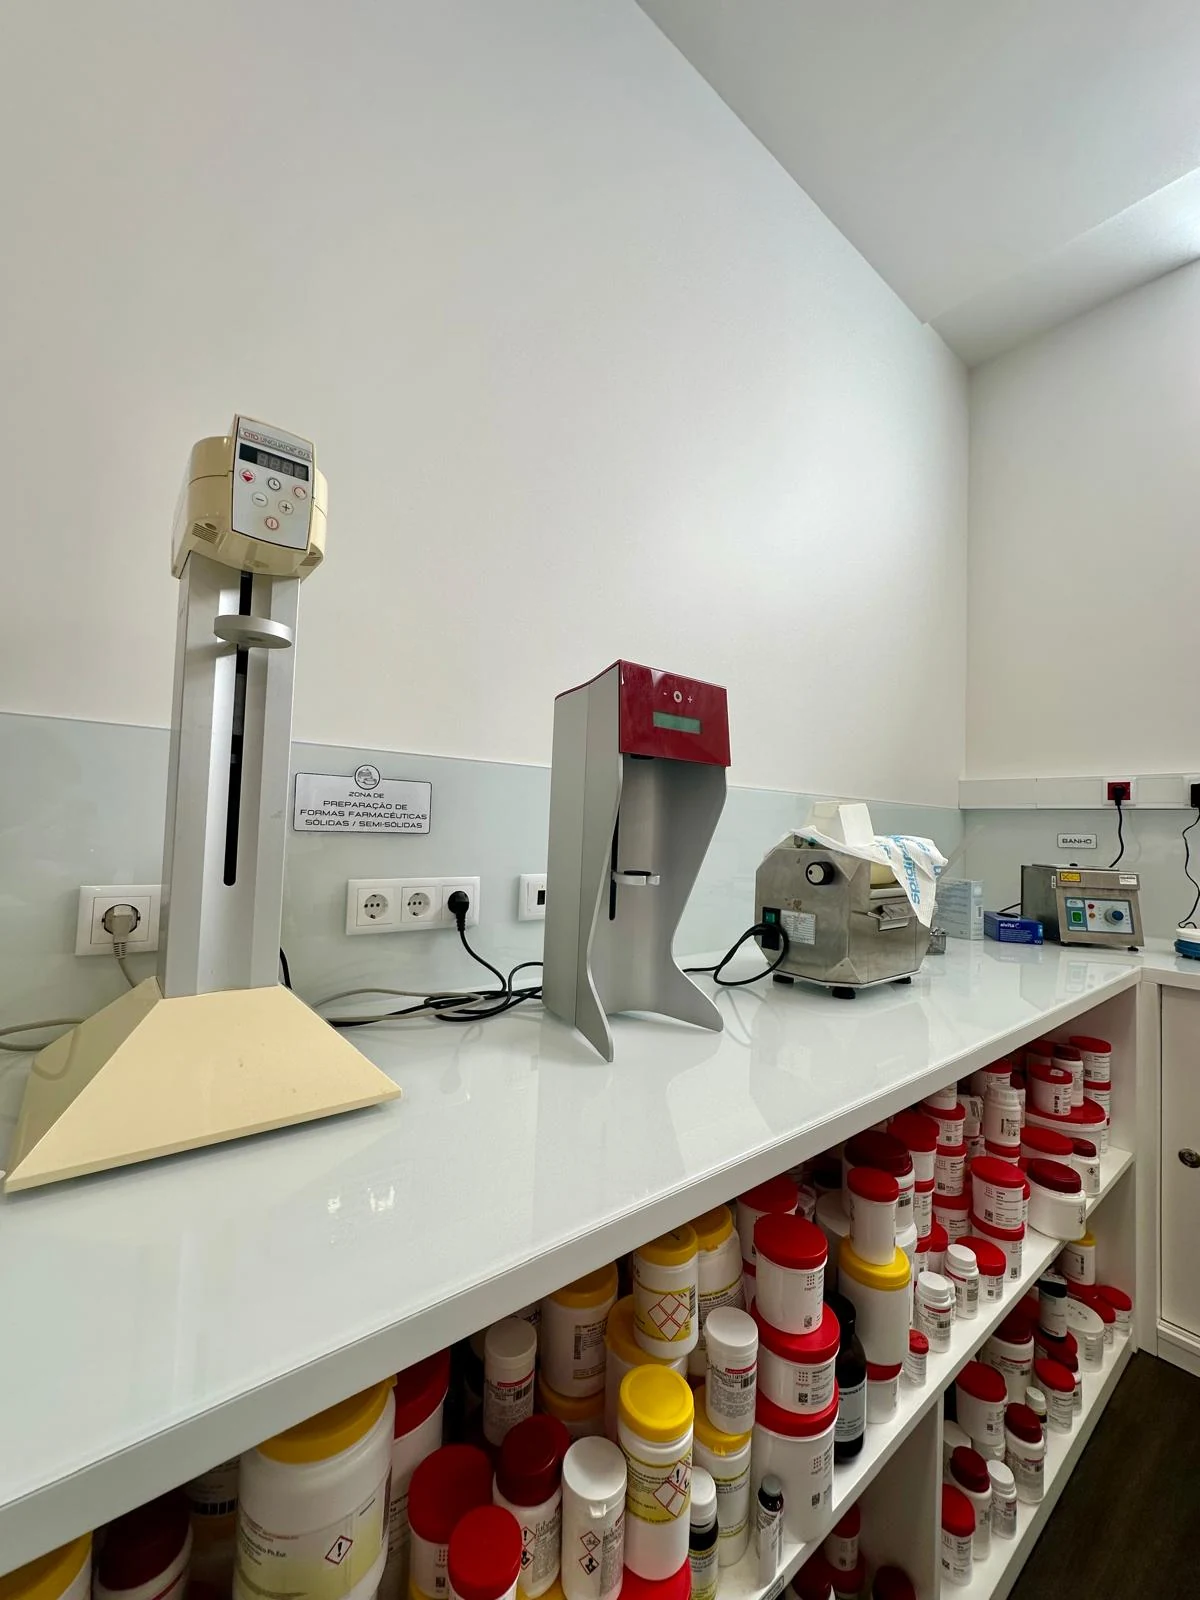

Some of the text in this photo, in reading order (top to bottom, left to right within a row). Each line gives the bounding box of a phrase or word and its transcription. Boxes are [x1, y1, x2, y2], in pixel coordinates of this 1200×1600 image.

[323, 800, 408, 811] PREPARAÇÃO DE
[299, 809, 428, 820] FORMAS FARMACÊUTICAS
[305, 819, 350, 827] SÓLIDAS
[358, 820, 423, 829] SEMI-SÓLIDAS
